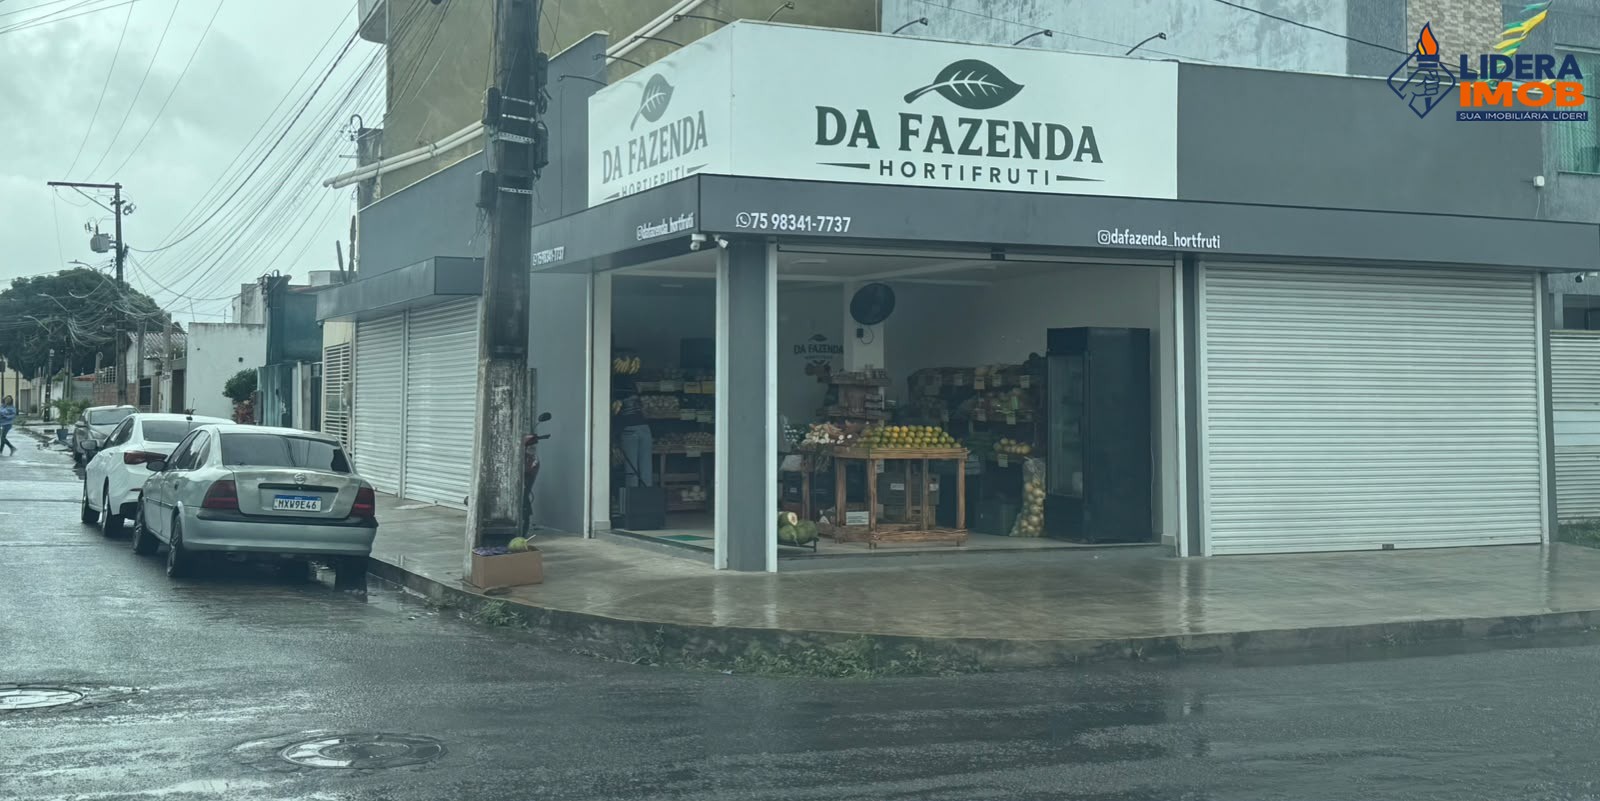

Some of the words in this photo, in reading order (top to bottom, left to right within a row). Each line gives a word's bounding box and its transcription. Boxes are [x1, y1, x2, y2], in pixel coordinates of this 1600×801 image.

[602, 145, 623, 184] DA
[628, 110, 708, 175] FAZENDA
[815, 105, 880, 149] DA
[898, 112, 1103, 163] FAZENDA
[879, 159, 1049, 185] HORTIFRUTI
[750, 212, 768, 229] 75
[771, 213, 851, 232] 98341-7737
[1111, 228, 1220, 248] dafazenda_hortfruti
